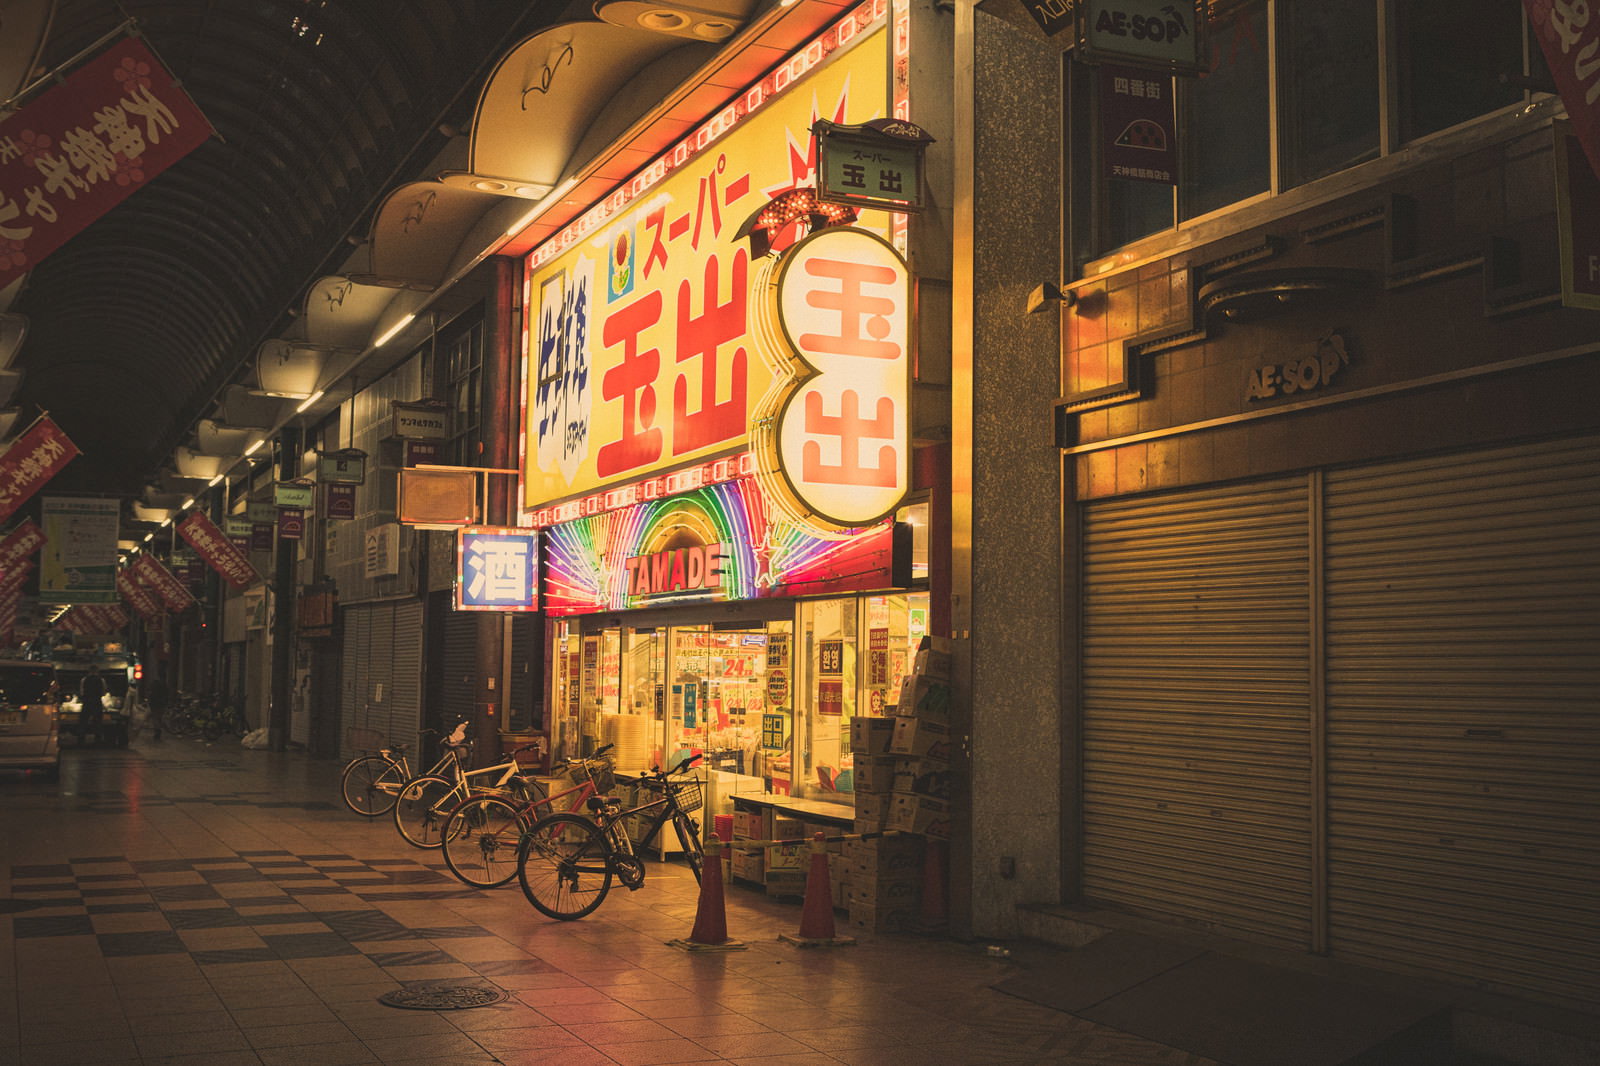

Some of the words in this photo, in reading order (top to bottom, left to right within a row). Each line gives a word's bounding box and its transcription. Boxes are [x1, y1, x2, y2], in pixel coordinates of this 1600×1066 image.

[1114, 77, 1161, 100] 四番街
[841, 164, 902, 193] 玉出
[854, 150, 892, 164] スーパー
[643, 153, 751, 280] スーパー
[597, 246, 749, 478] 玉出
[799, 256, 902, 488] 玉出
[467, 539, 528, 601] 酒
[626, 542, 721, 596] TAMADE
